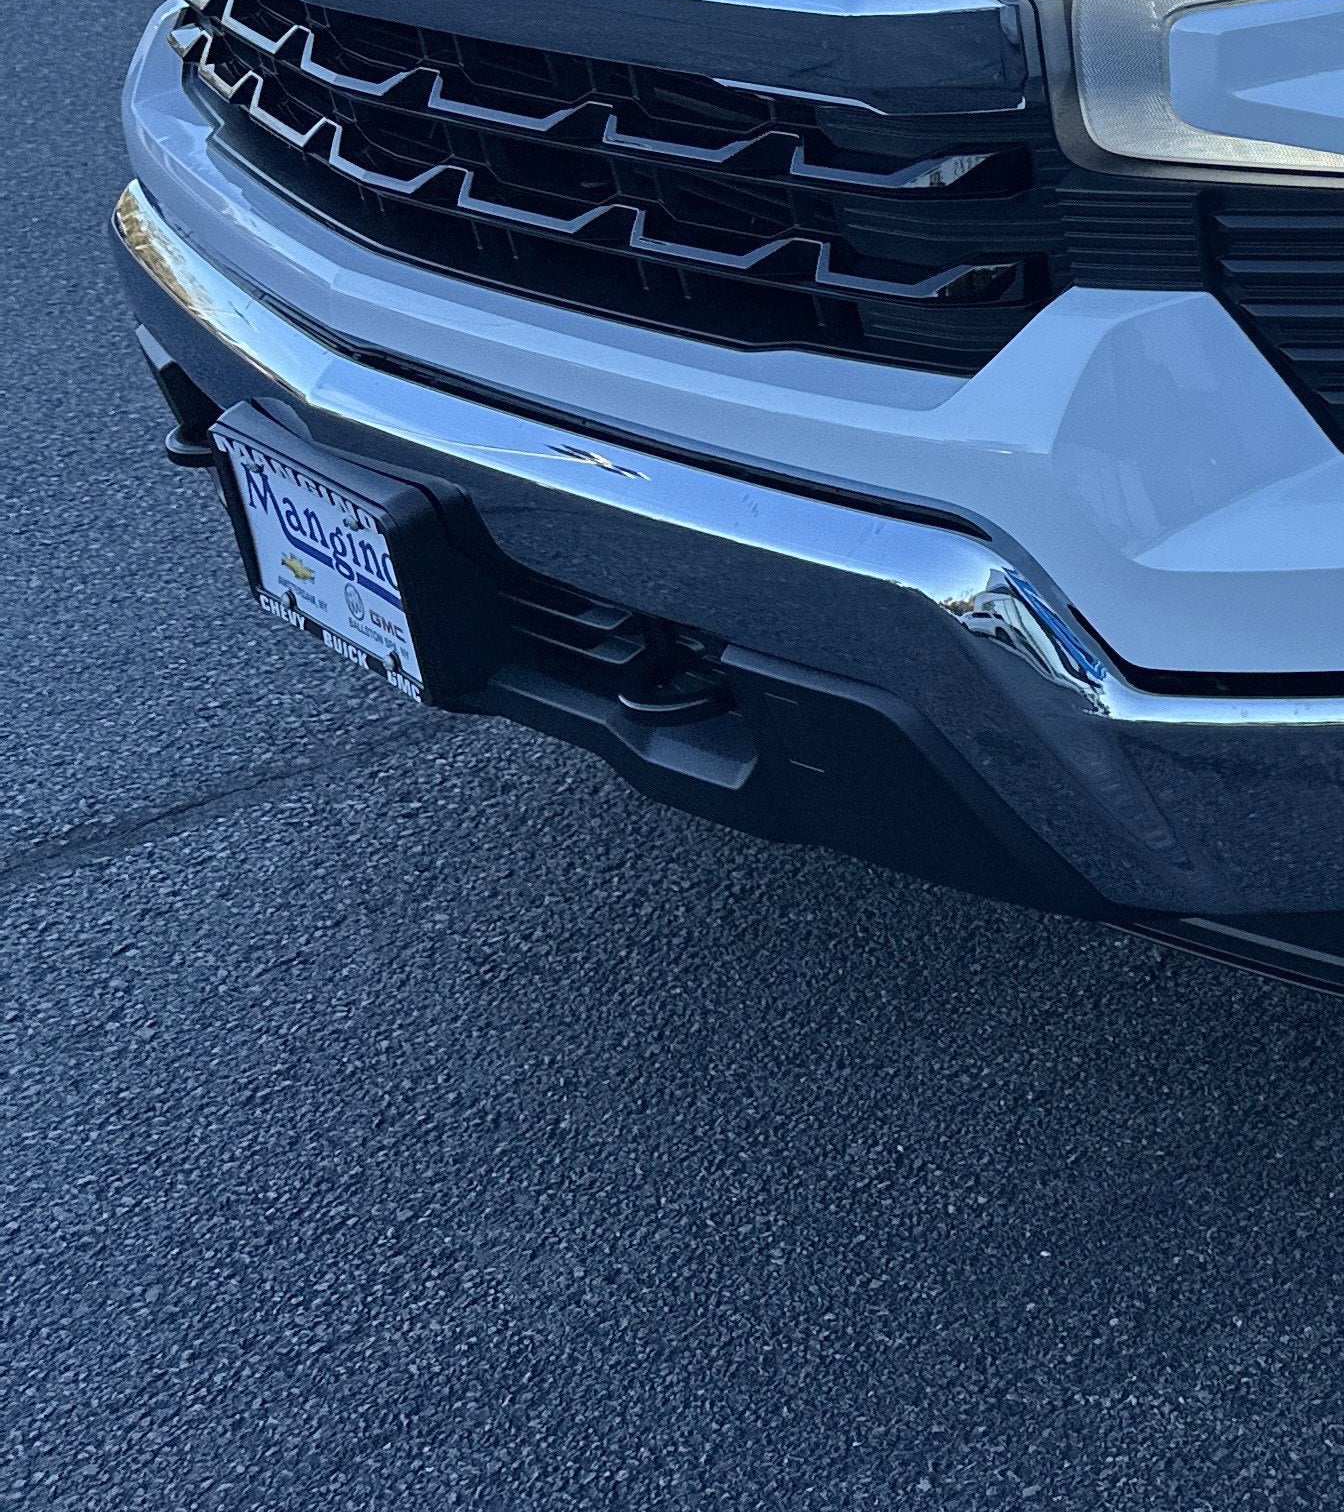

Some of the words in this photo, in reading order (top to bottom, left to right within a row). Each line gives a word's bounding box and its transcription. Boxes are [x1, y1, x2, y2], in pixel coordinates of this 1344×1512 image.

[240, 461, 399, 591] Mangino
[259, 594, 305, 631] CHEVY
[322, 629, 370, 670] BUICK
[386, 670, 422, 703] GMC
[369, 609, 407, 644] GMC
